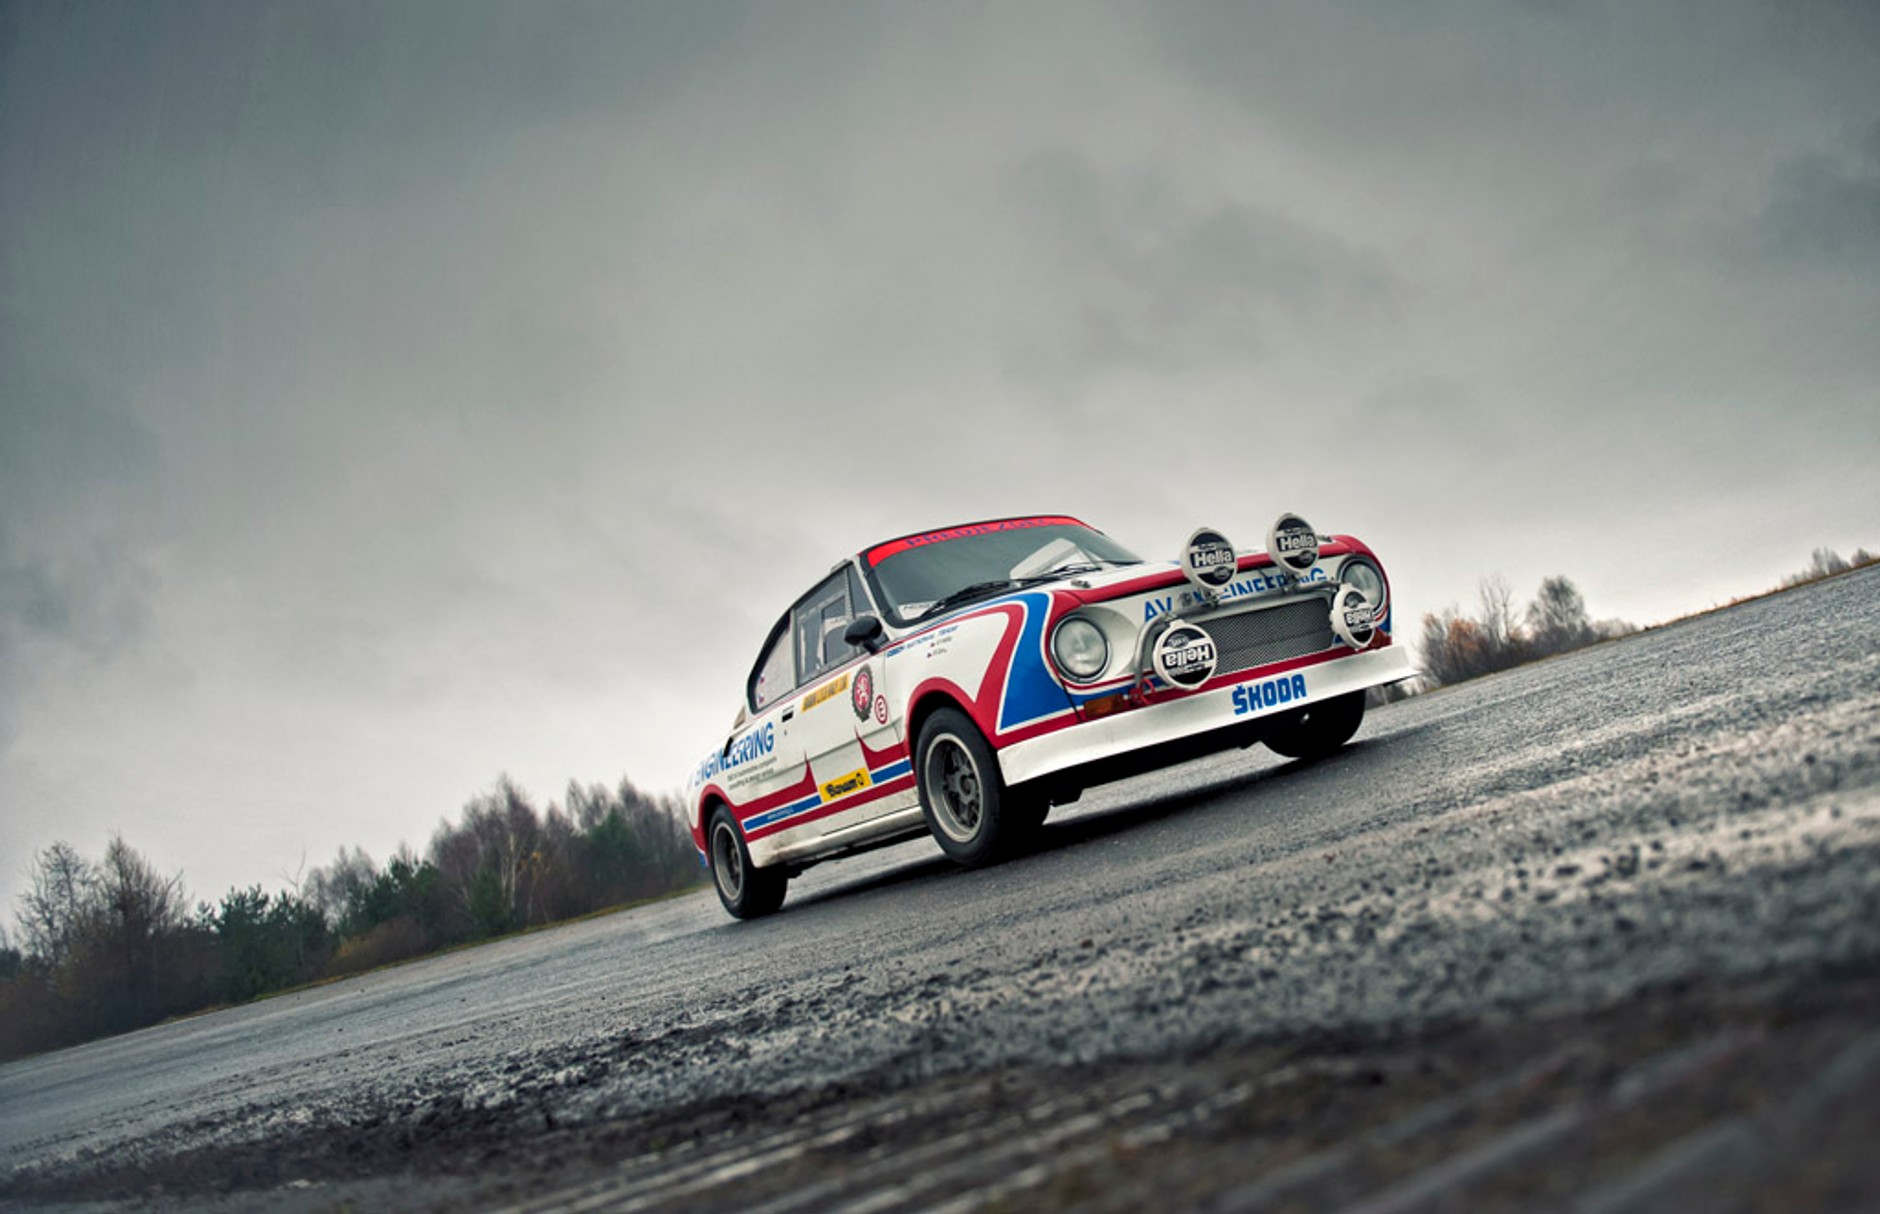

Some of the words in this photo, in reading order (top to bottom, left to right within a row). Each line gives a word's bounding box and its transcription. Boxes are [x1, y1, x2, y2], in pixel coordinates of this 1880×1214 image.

[1280, 534, 1315, 551] Hella
[1194, 551, 1233, 567] Hella
[1144, 597, 1173, 623] AV
[1165, 646, 1209, 667] Hella
[1231, 673, 1307, 716] ŠKODA
